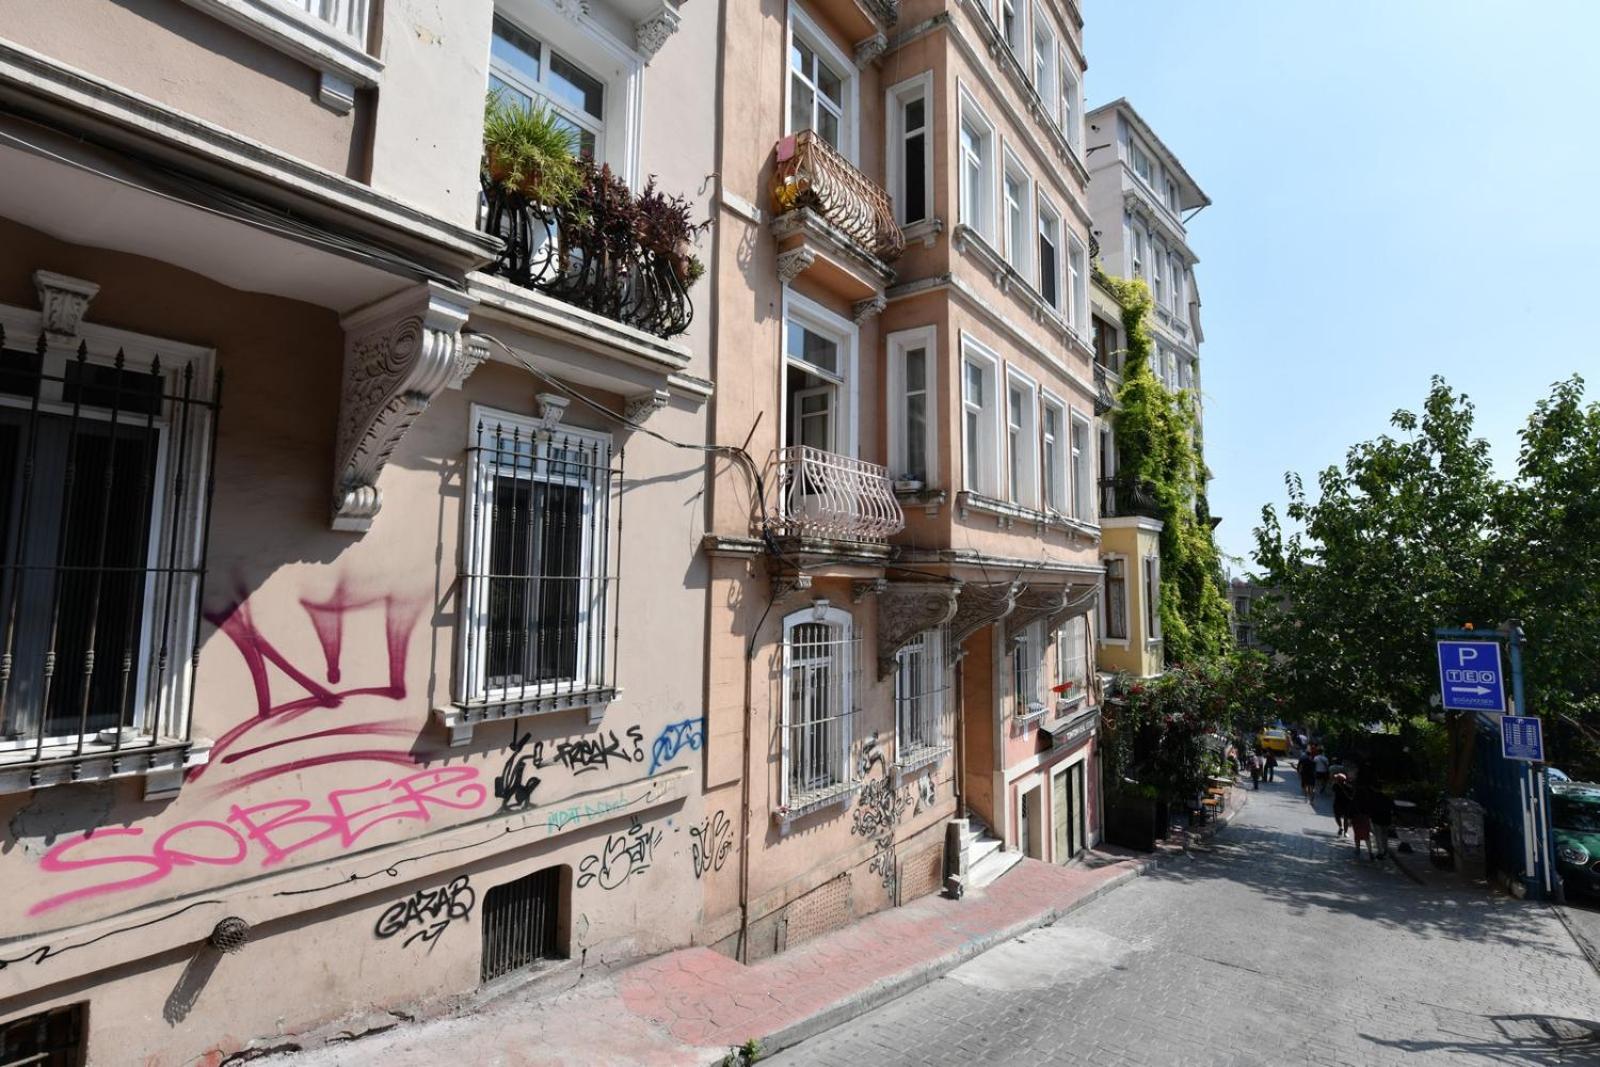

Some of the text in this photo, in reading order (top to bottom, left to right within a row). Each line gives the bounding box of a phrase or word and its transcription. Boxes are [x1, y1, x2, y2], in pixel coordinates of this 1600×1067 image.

[1458, 647, 1479, 667] P
[1447, 670, 1495, 683] TEO
[25, 766, 488, 918] SOBER
